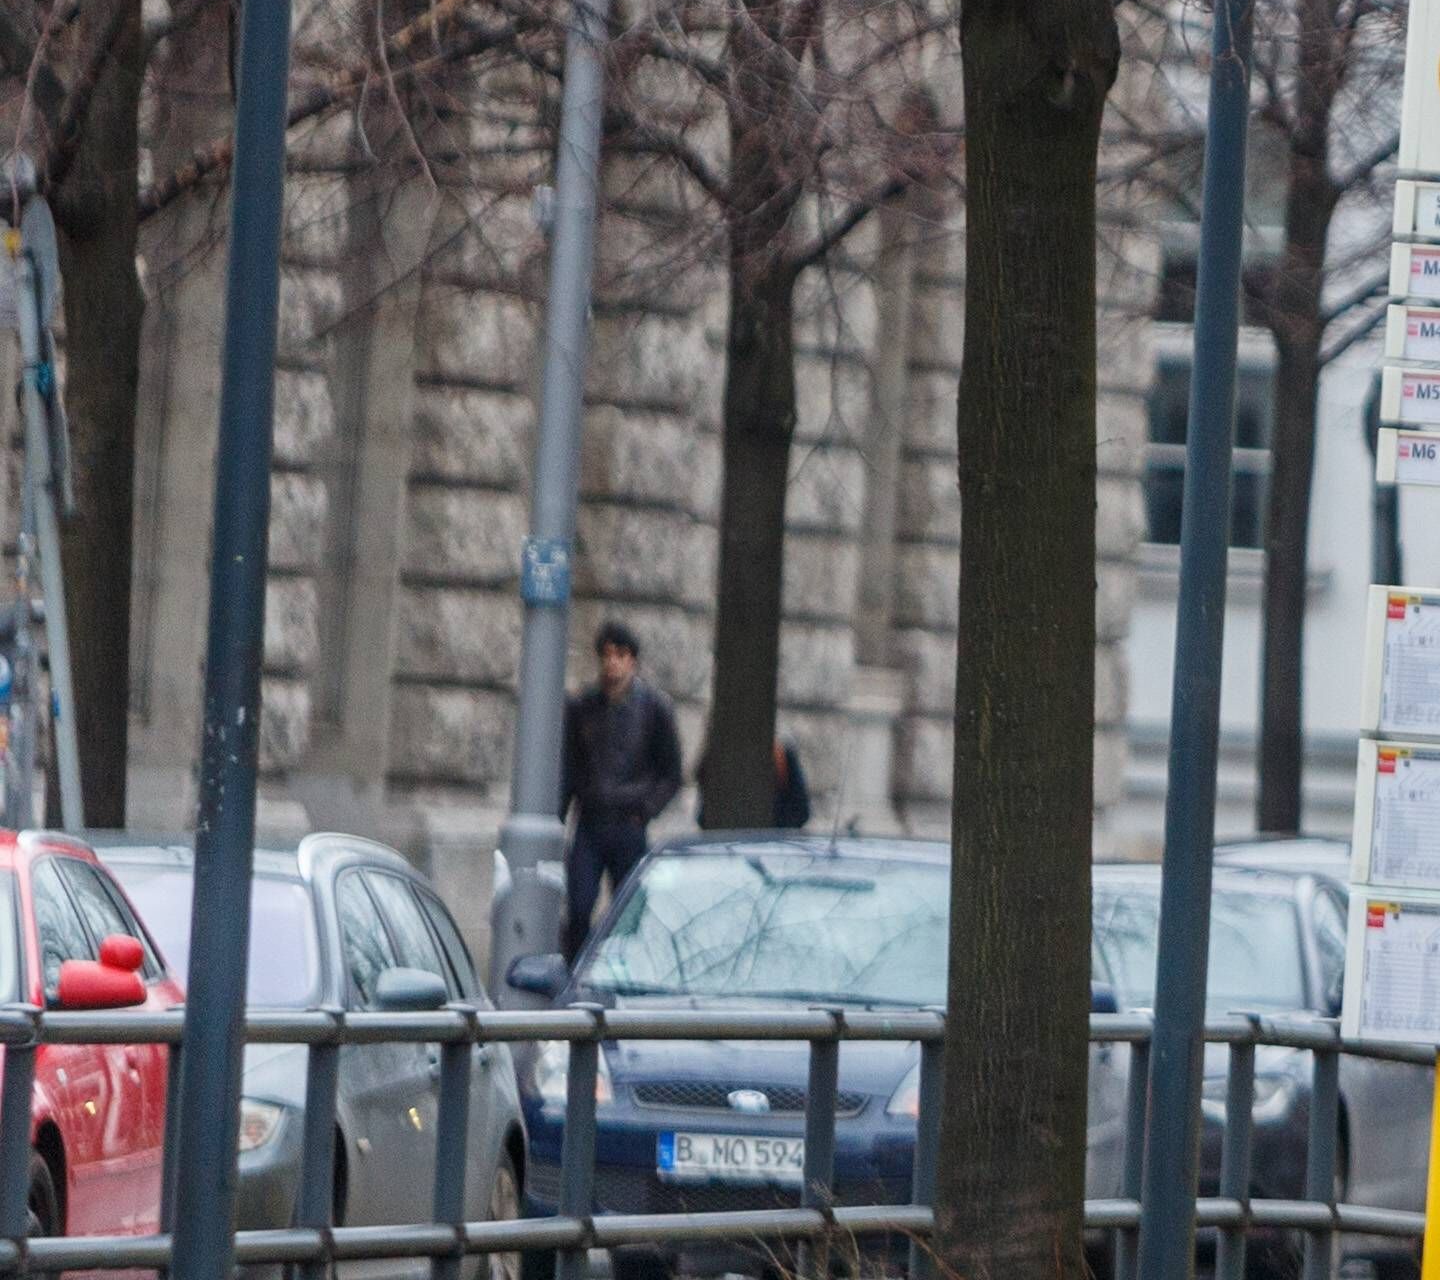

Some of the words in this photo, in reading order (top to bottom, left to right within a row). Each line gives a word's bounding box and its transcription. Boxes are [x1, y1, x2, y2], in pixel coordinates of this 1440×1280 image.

[1416, 384, 1440, 401] M5
[1411, 443, 1436, 460] M6
[676, 1136, 693, 1163] B
